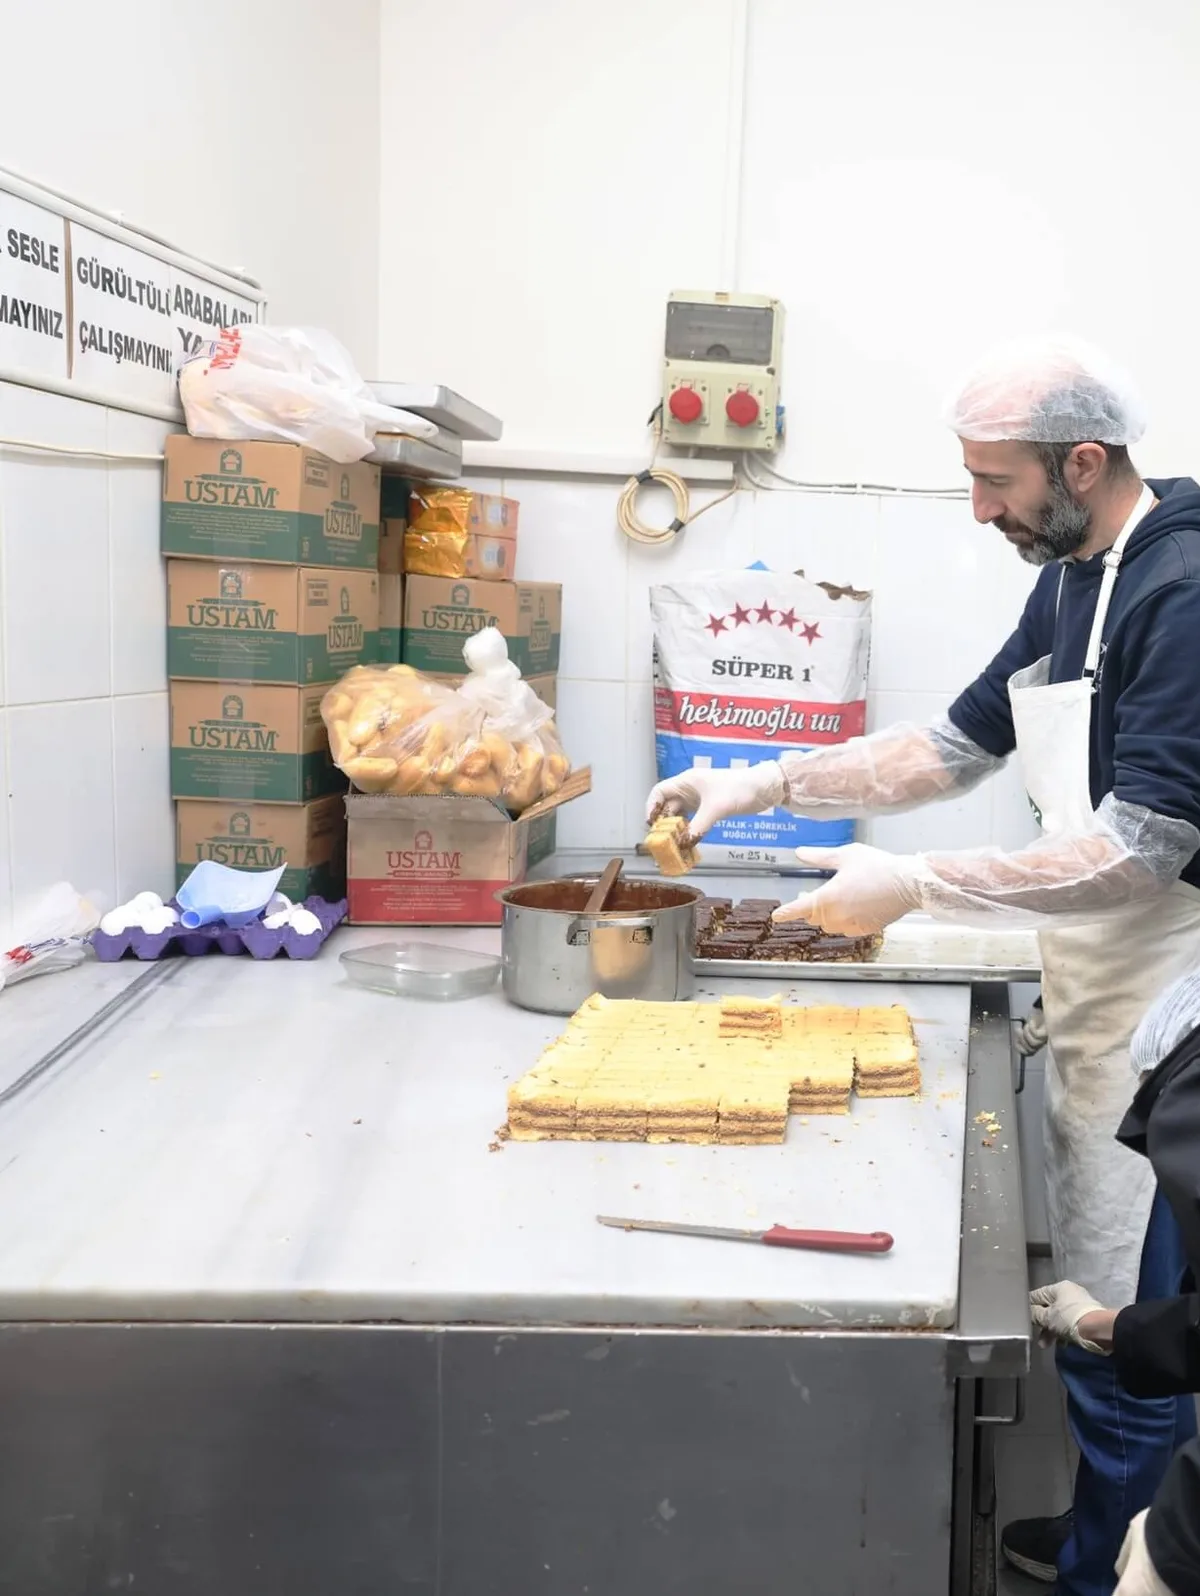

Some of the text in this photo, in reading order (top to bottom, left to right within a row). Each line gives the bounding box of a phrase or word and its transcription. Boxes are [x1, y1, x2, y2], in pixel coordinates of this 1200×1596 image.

[7, 228, 59, 273] SESLE
[79, 320, 172, 374] ÇALIŞMAYINI
[184, 480, 277, 509] USTAM
[186, 605, 277, 630] USTAM
[422, 610, 498, 632] USTAM
[711, 656, 811, 682] SÜPER 1
[679, 696, 804, 736] hekimoğlu
[810, 713, 842, 733] un
[188, 726, 277, 751] USTAM
[195, 843, 284, 867] USTAM
[385, 851, 461, 869] USTAM
[728, 851, 776, 863] Net 25 kg
